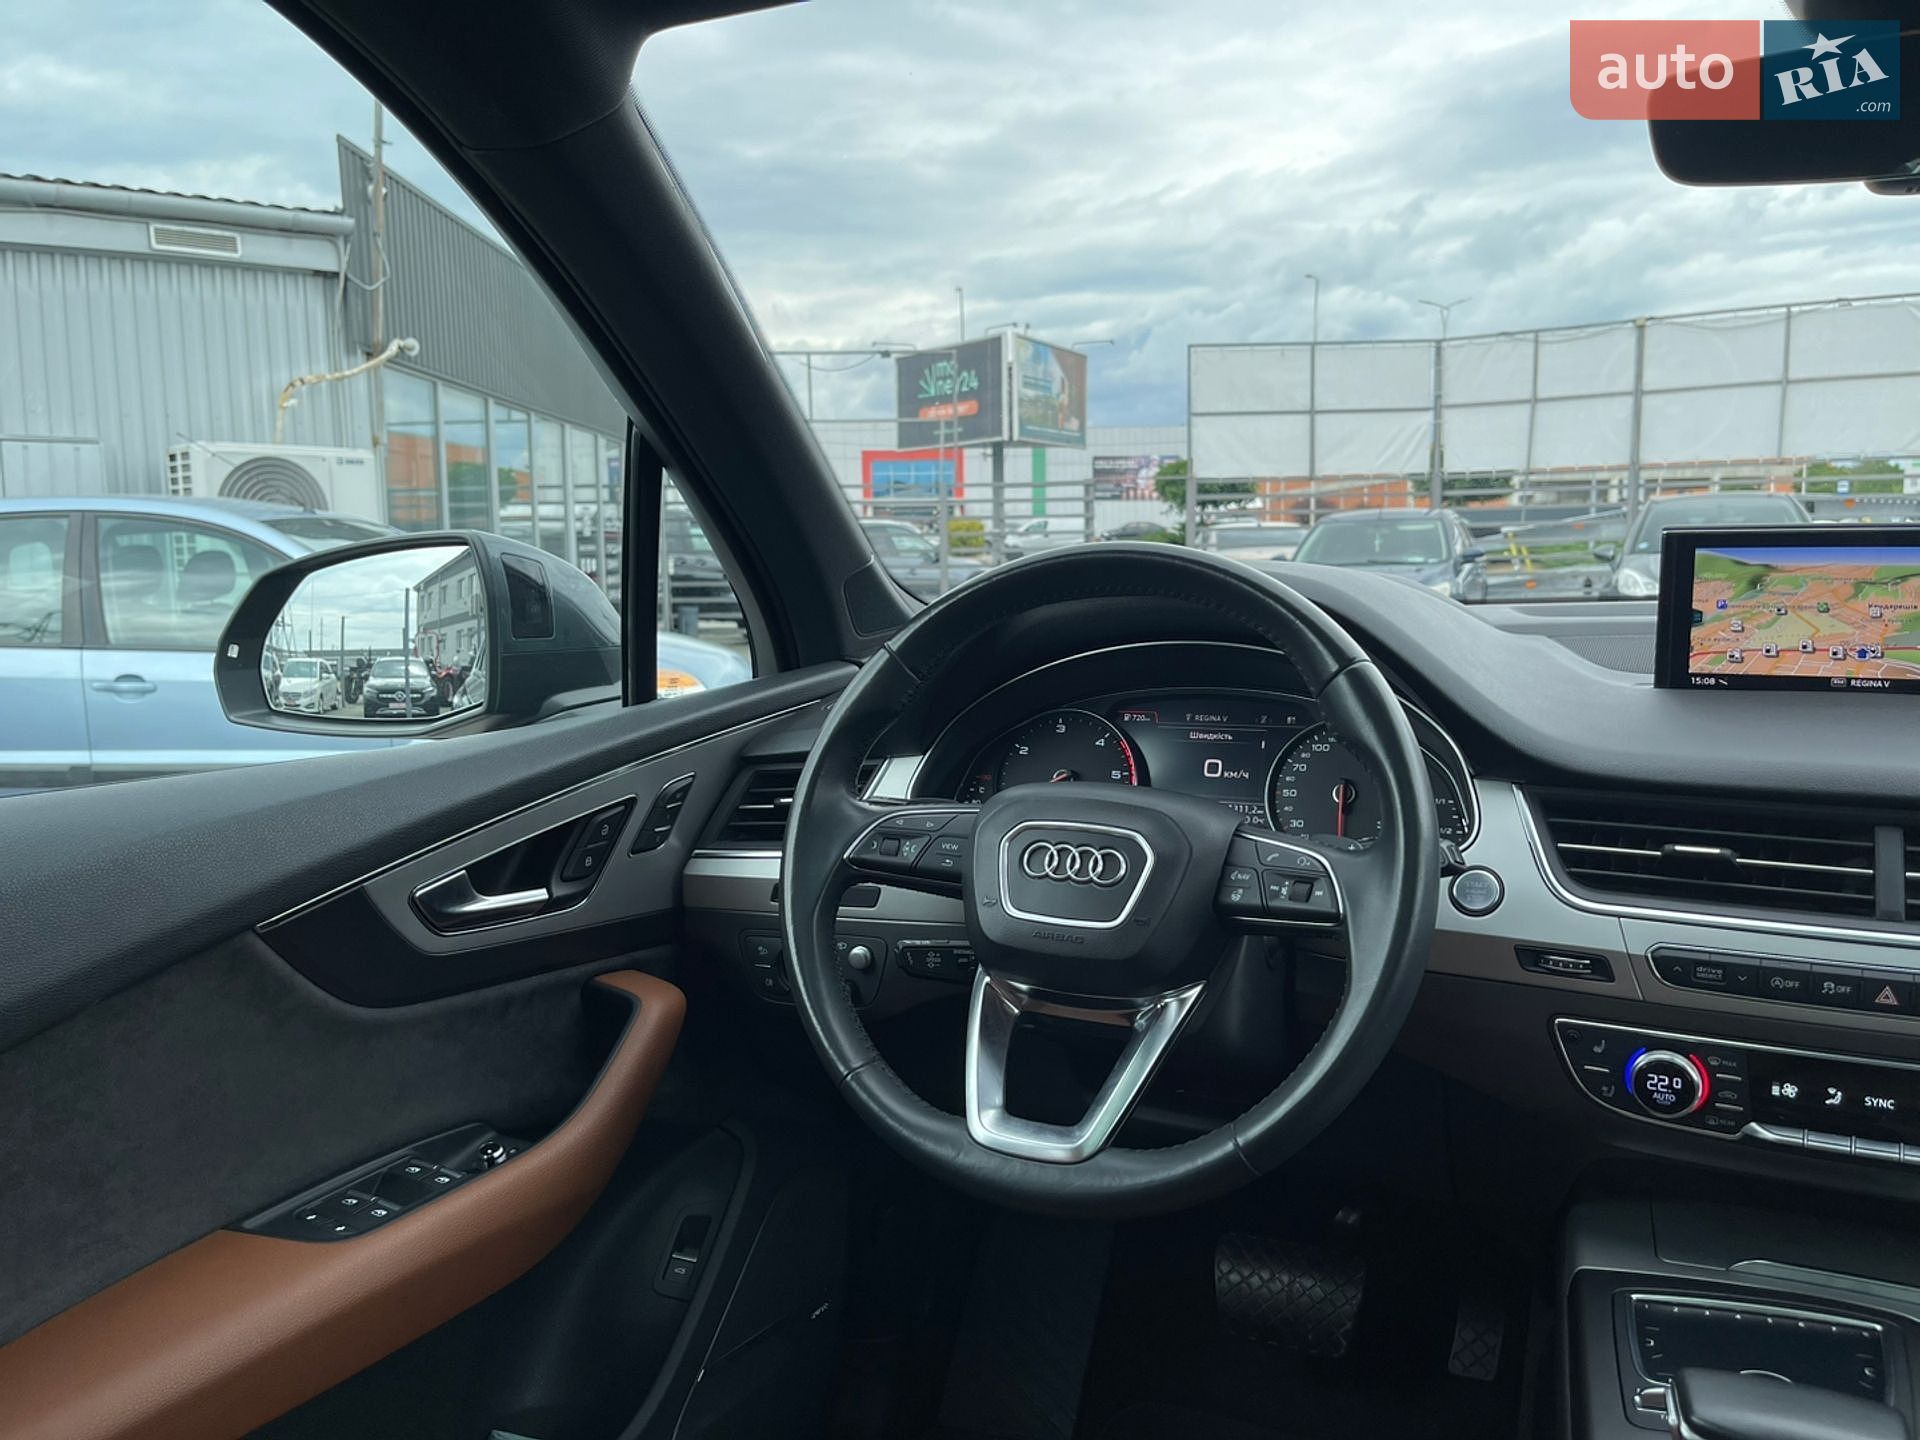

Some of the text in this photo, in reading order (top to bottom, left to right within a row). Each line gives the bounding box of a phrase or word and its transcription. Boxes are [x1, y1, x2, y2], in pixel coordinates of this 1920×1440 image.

[1690, 677, 1716, 686] 15:08
[1850, 678, 1882, 688] REGINA
[1883, 679, 1891, 688] V
[1055, 723, 1067, 734] 3
[1095, 738, 1106, 748] 4
[1311, 743, 1331, 752] 100
[1019, 745, 1029, 755] 2
[1203, 757, 1223, 778] 0
[1292, 763, 1307, 772] 70
[1110, 770, 1122, 780] 5
[1282, 789, 1298, 797] 50
[1289, 819, 1304, 828] 30
[941, 842, 959, 851] VIEW
[1032, 930, 1085, 945] AIRBAG
[1784, 979, 1801, 989] OFF
[1835, 985, 1853, 994] OFF
[1646, 1073, 1682, 1093] 22.0
[1652, 1091, 1676, 1102] AUTO
[1864, 1094, 1895, 1111] SYNC
